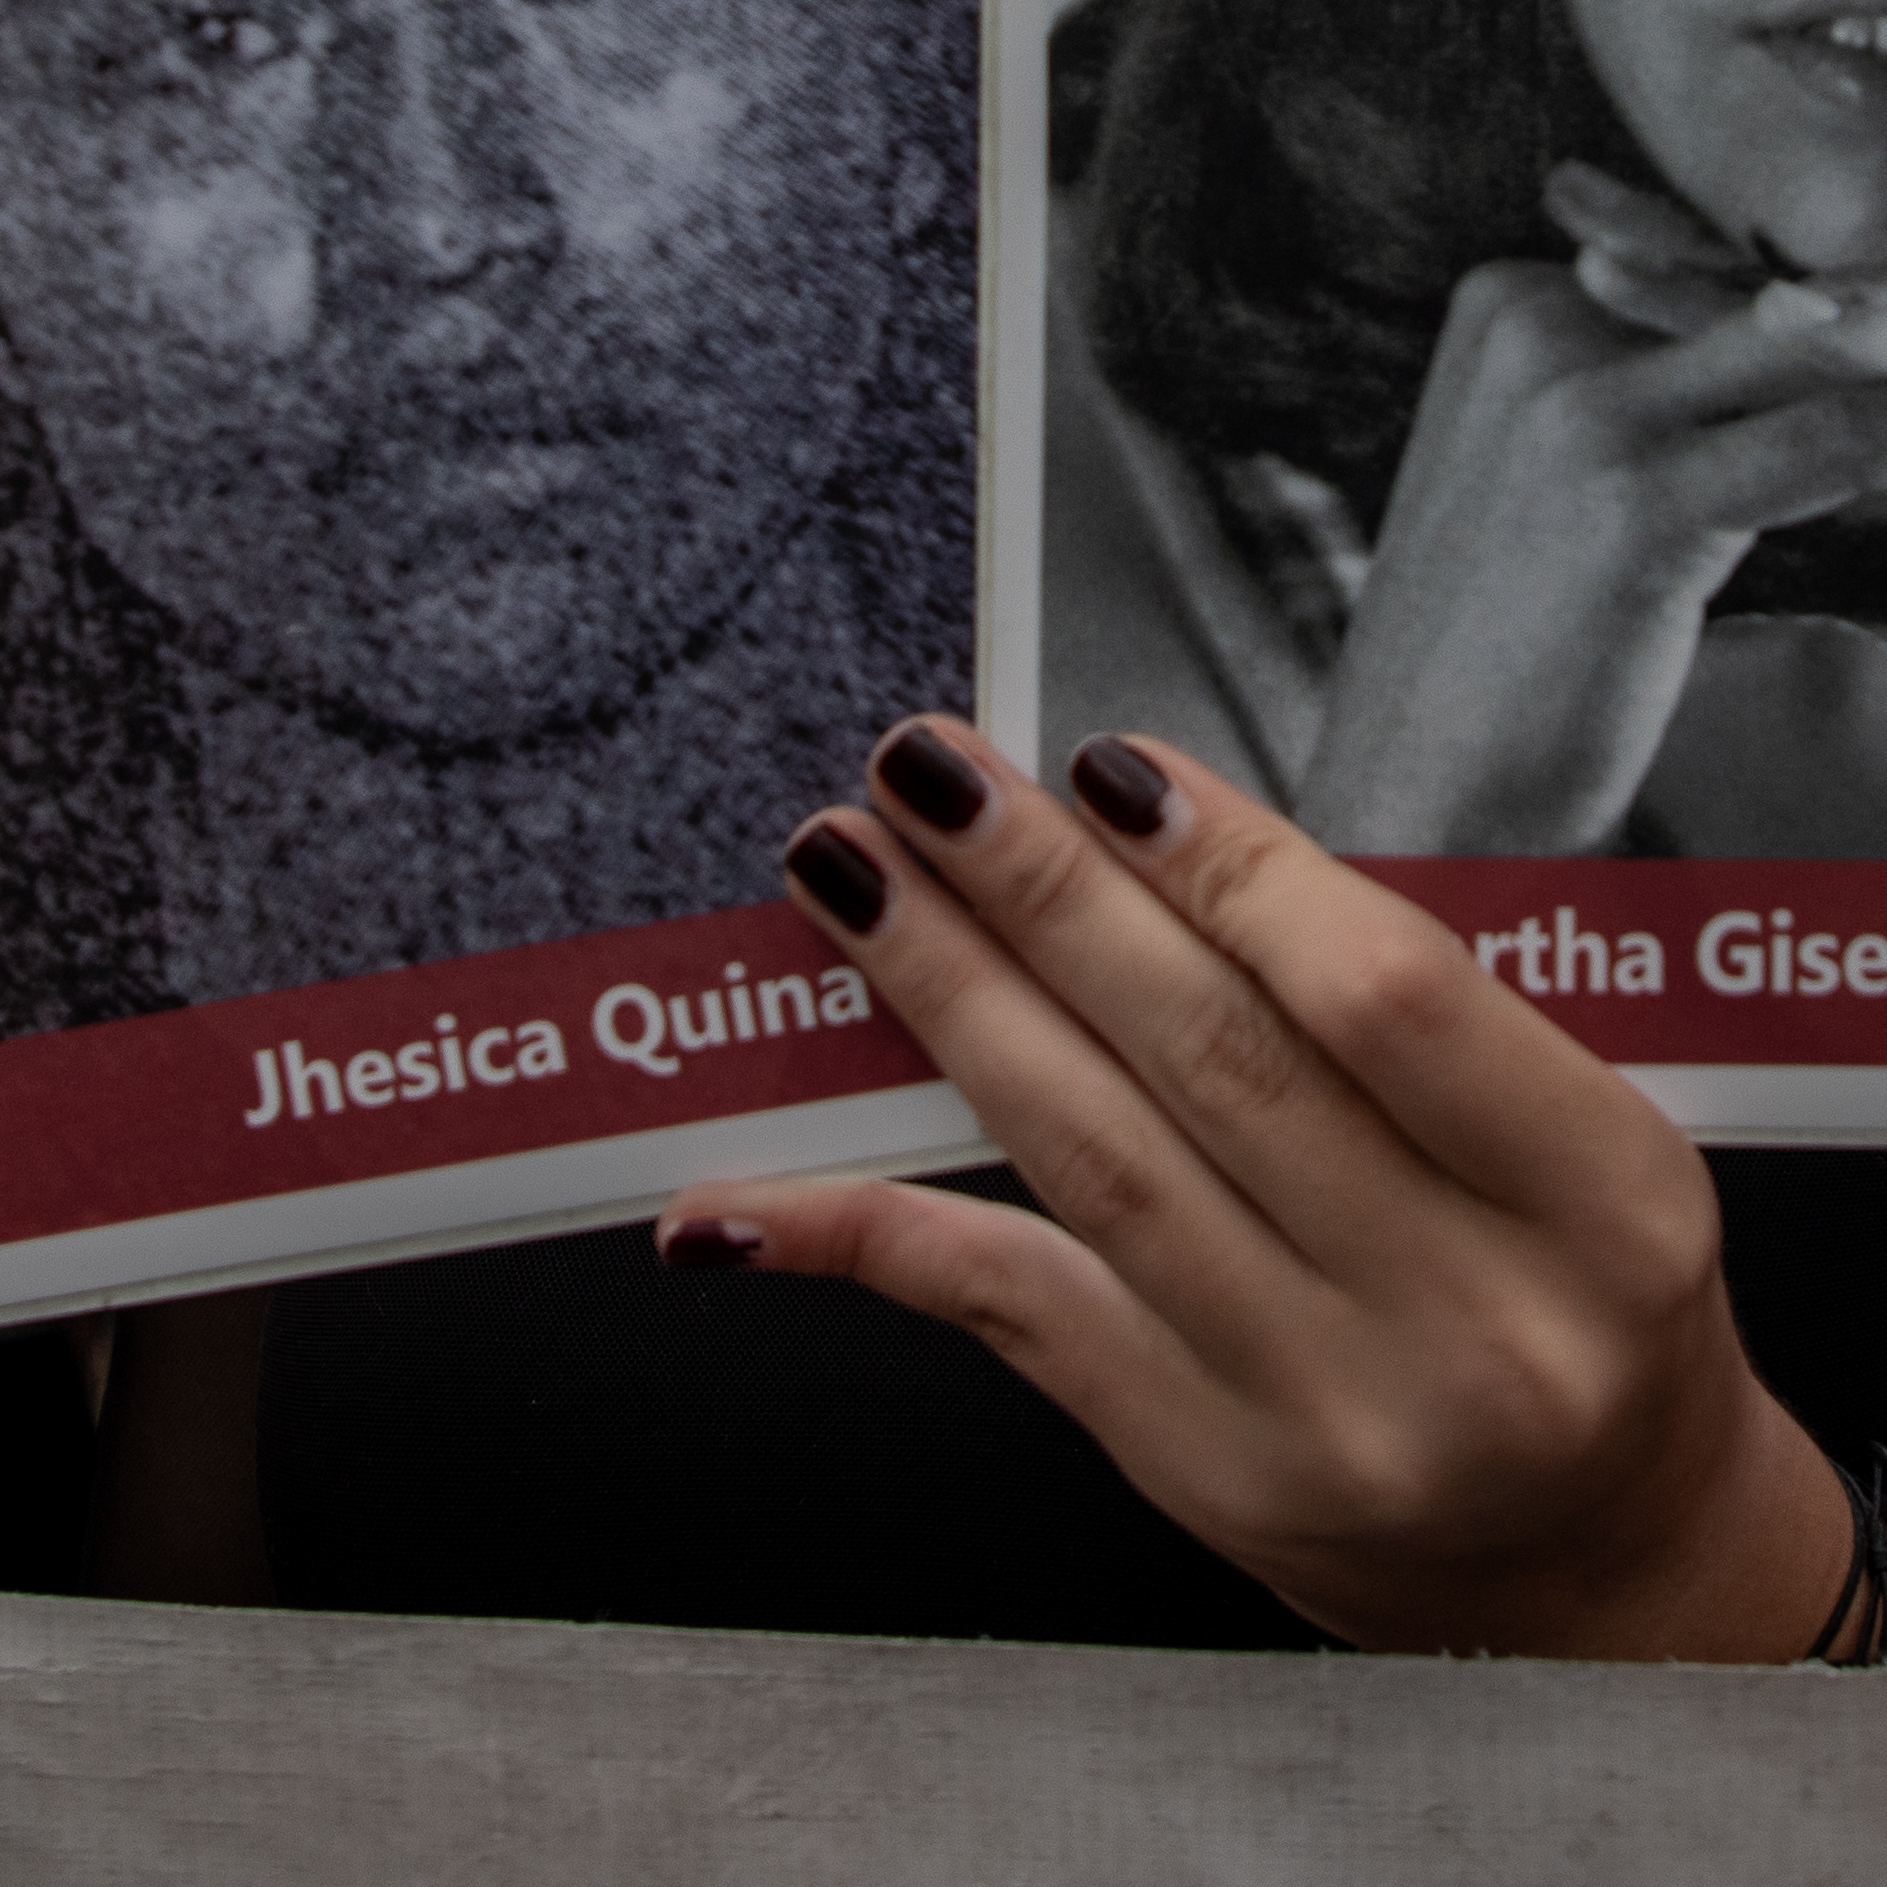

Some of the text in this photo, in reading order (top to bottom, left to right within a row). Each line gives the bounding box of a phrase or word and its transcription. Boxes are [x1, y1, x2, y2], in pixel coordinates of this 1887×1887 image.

[1473, 907, 1666, 997] rtha
[243, 961, 874, 1128] Jhesica Quina
